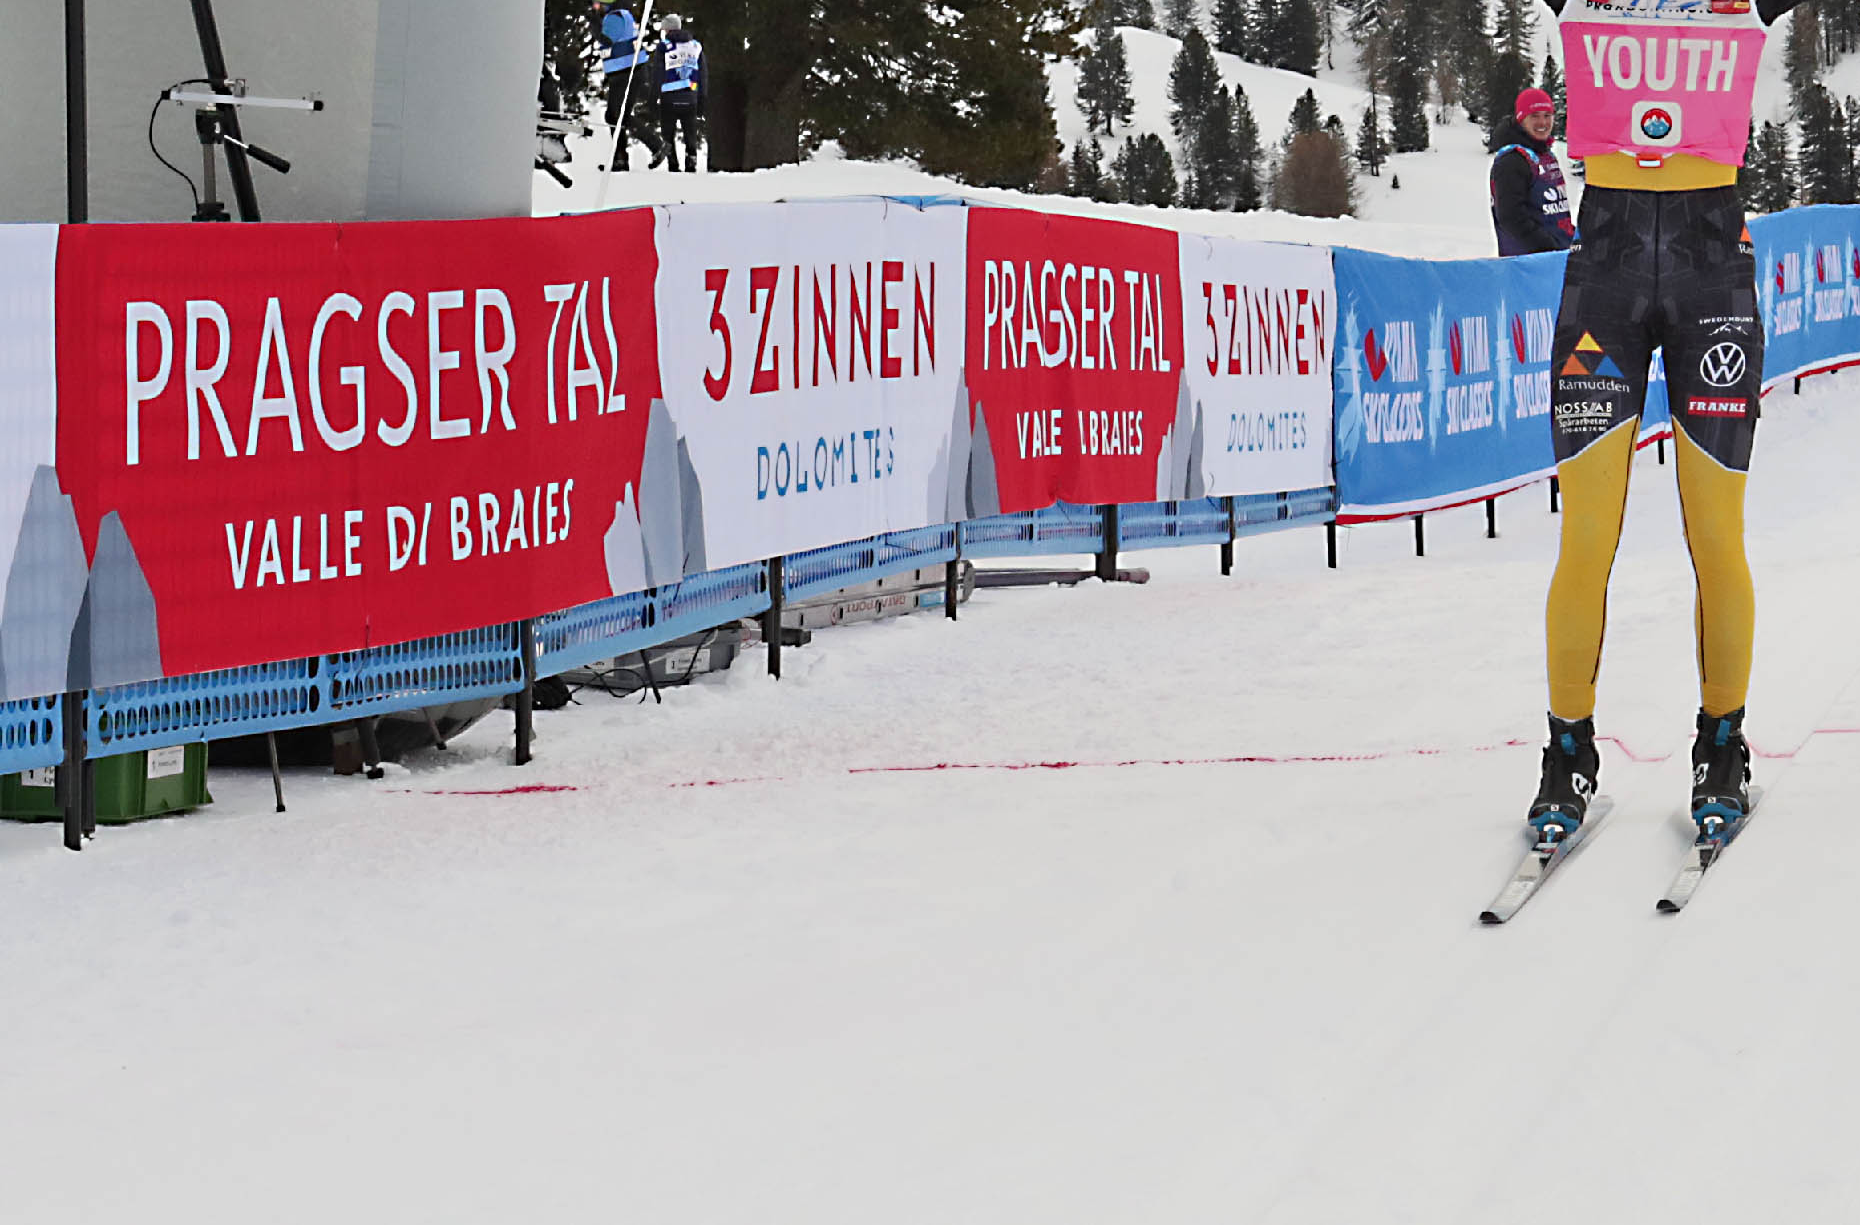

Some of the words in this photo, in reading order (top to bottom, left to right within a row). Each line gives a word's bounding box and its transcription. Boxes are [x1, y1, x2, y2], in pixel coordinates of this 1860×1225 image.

[1583, 34, 1738, 92] YOUTH
[983, 259, 1118, 371] PRAGSER
[1124, 269, 1171, 373] TAL
[126, 287, 516, 466] PRAGSER
[543, 276, 626, 425] TAL
[1558, 379, 1630, 393] Ramudden
[1089, 409, 1143, 455] BRAIES
[1227, 411, 1307, 452] DOLOMITES
[1554, 401, 1588, 415] NOSS
[1594, 401, 1613, 414] AB
[1688, 400, 1747, 413] FRANKE
[757, 426, 894, 500] DOLOMITES
[226, 510, 364, 590] VALLE
[386, 502, 432, 573] DI
[450, 478, 574, 562] BRAIES
